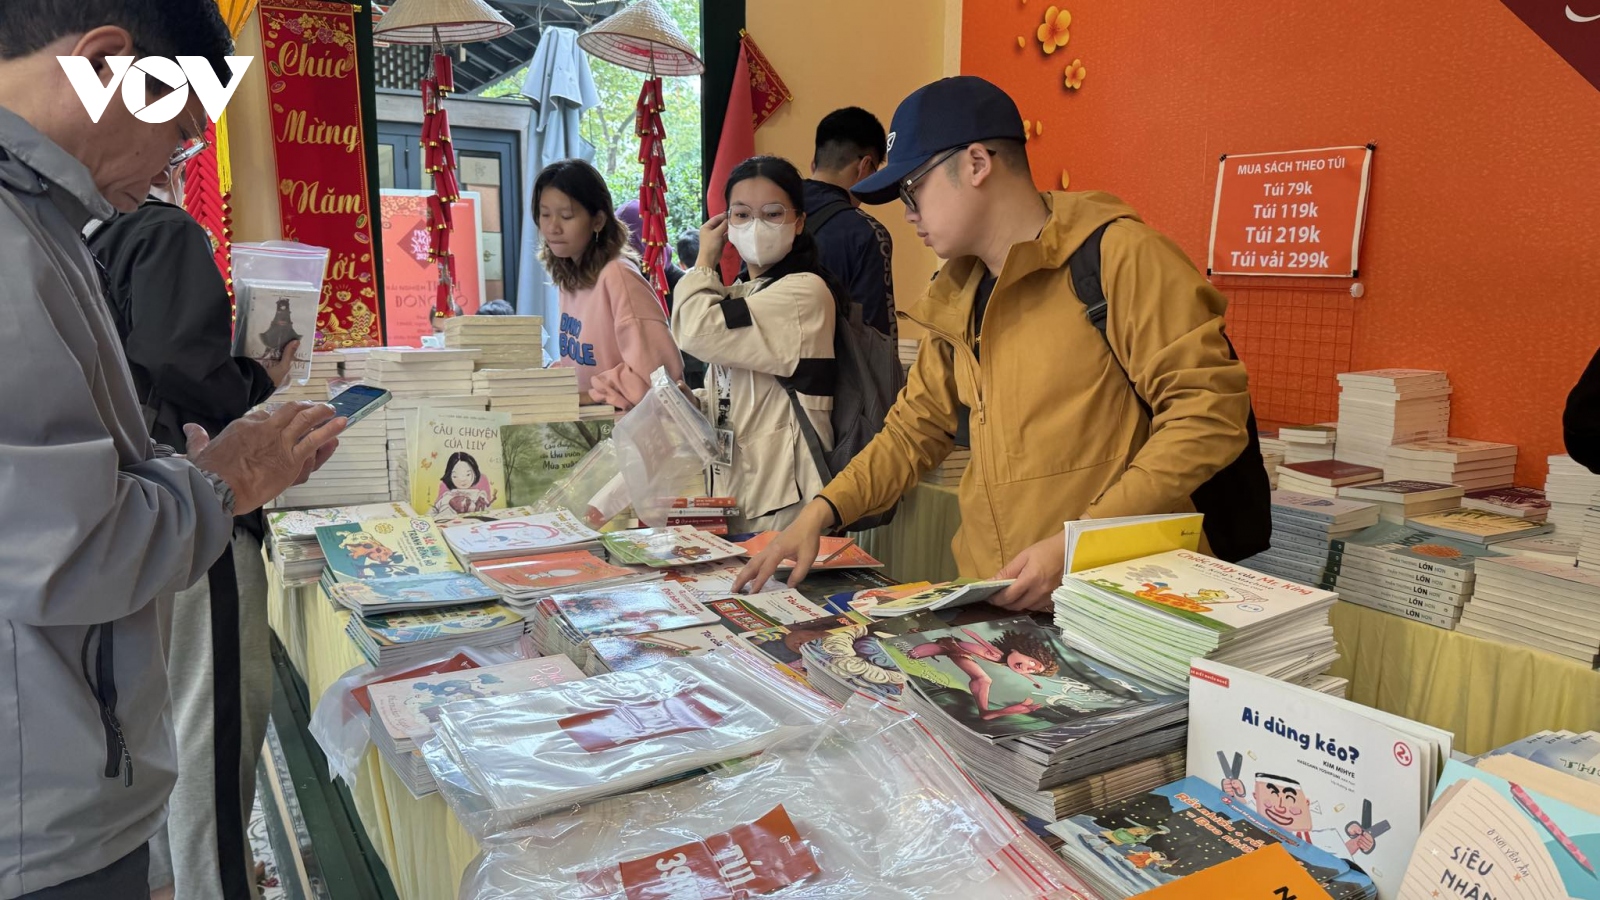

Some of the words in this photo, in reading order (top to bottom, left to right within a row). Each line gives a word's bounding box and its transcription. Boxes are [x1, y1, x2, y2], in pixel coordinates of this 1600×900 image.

[278, 40, 350, 79] Chúc
[276, 109, 360, 153] Mừng
[1237, 163, 1262, 175] MUA
[1264, 160, 1293, 174] SÁCH
[1295, 159, 1325, 172] THEO
[1328, 155, 1345, 169] TÚI
[290, 180, 365, 214] Năm
[1263, 182, 1284, 196] Túi
[1287, 181, 1313, 196] 79k
[1253, 203, 1277, 219] Túi
[1281, 202, 1318, 218] 119k
[1245, 226, 1272, 243] Túi
[1275, 225, 1321, 243] 219k
[323, 252, 360, 281] ới
[1230, 251, 1256, 267] Túi
[1259, 250, 1284, 268] vải
[1287, 252, 1329, 268] 299k
[433, 423, 453, 435] CÂU
[459, 427, 498, 440] CHUYỆN
[466, 440, 486, 450] LILY
[561, 460, 578, 469] xuâ
[1418, 562, 1434, 571] LỚN
[1211, 560, 1237, 573] máy
[1281, 583, 1314, 596] King
[1415, 574, 1431, 583] LỚN
[1413, 586, 1428, 595] LỚN
[1408, 597, 1424, 607] LỚN
[1405, 608, 1420, 618] LỚN
[1242, 706, 1259, 726] Ai
[1264, 716, 1311, 750] dùng
[1315, 732, 1360, 765] kéo?
[1322, 760, 1335, 770] KIM
[1335, 766, 1355, 779] MIHYE
[1487, 828, 1496, 836] Ở
[1493, 834, 1507, 849] NƠI
[1504, 848, 1521, 864] YÊN
